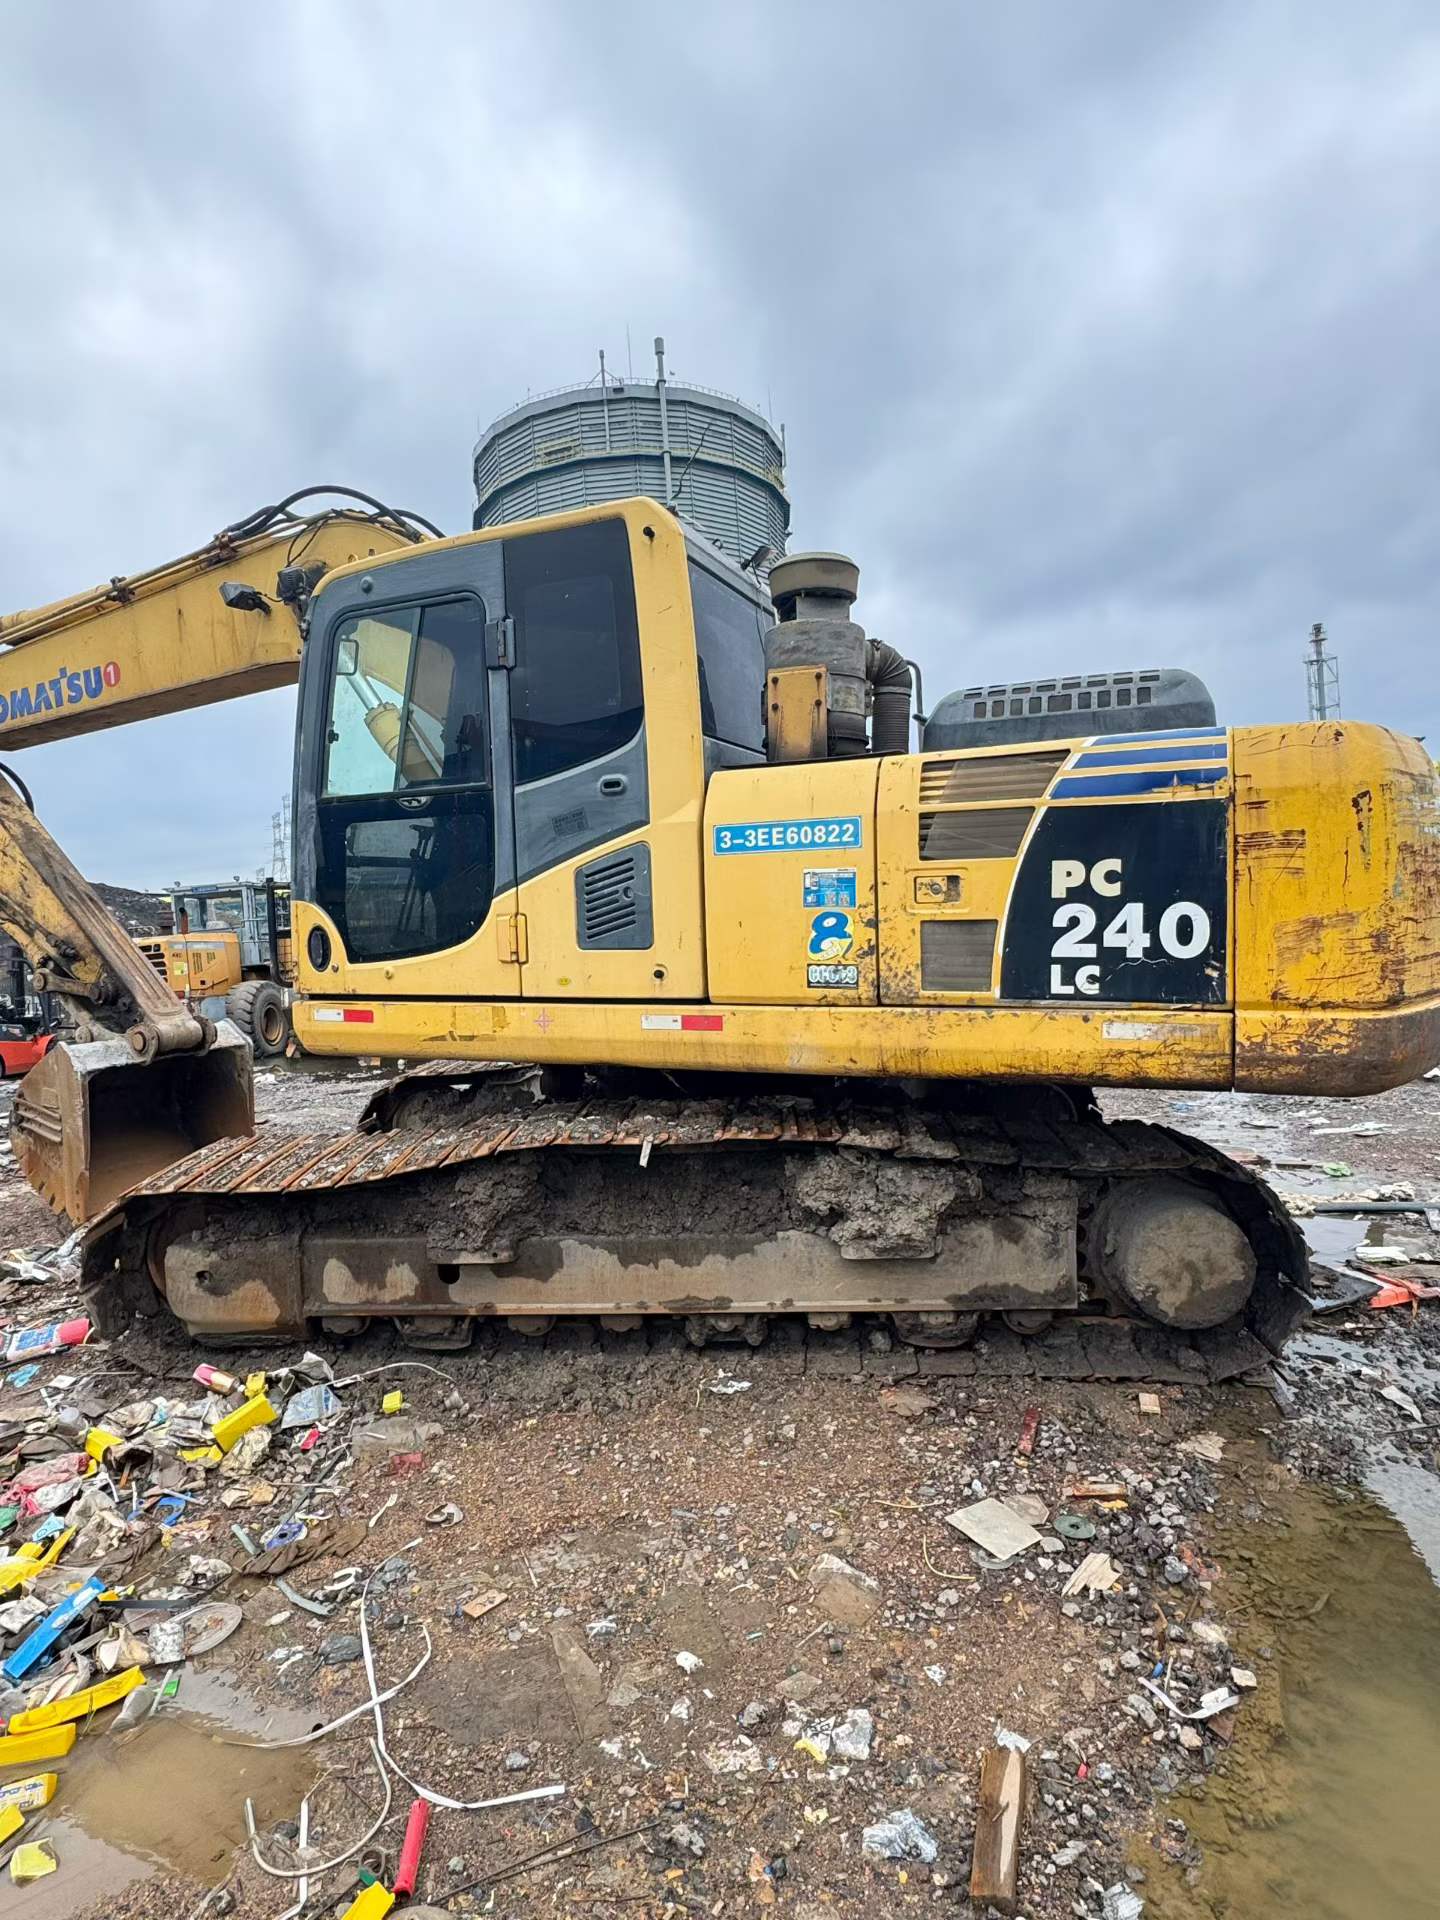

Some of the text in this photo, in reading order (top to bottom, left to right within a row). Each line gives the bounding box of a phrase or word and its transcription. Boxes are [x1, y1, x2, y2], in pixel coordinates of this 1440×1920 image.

[720, 823, 855, 849] 3-3EE60822
[1051, 858, 1122, 898] PC
[1051, 901, 1211, 959] 240
[1050, 964, 1100, 995] LC
